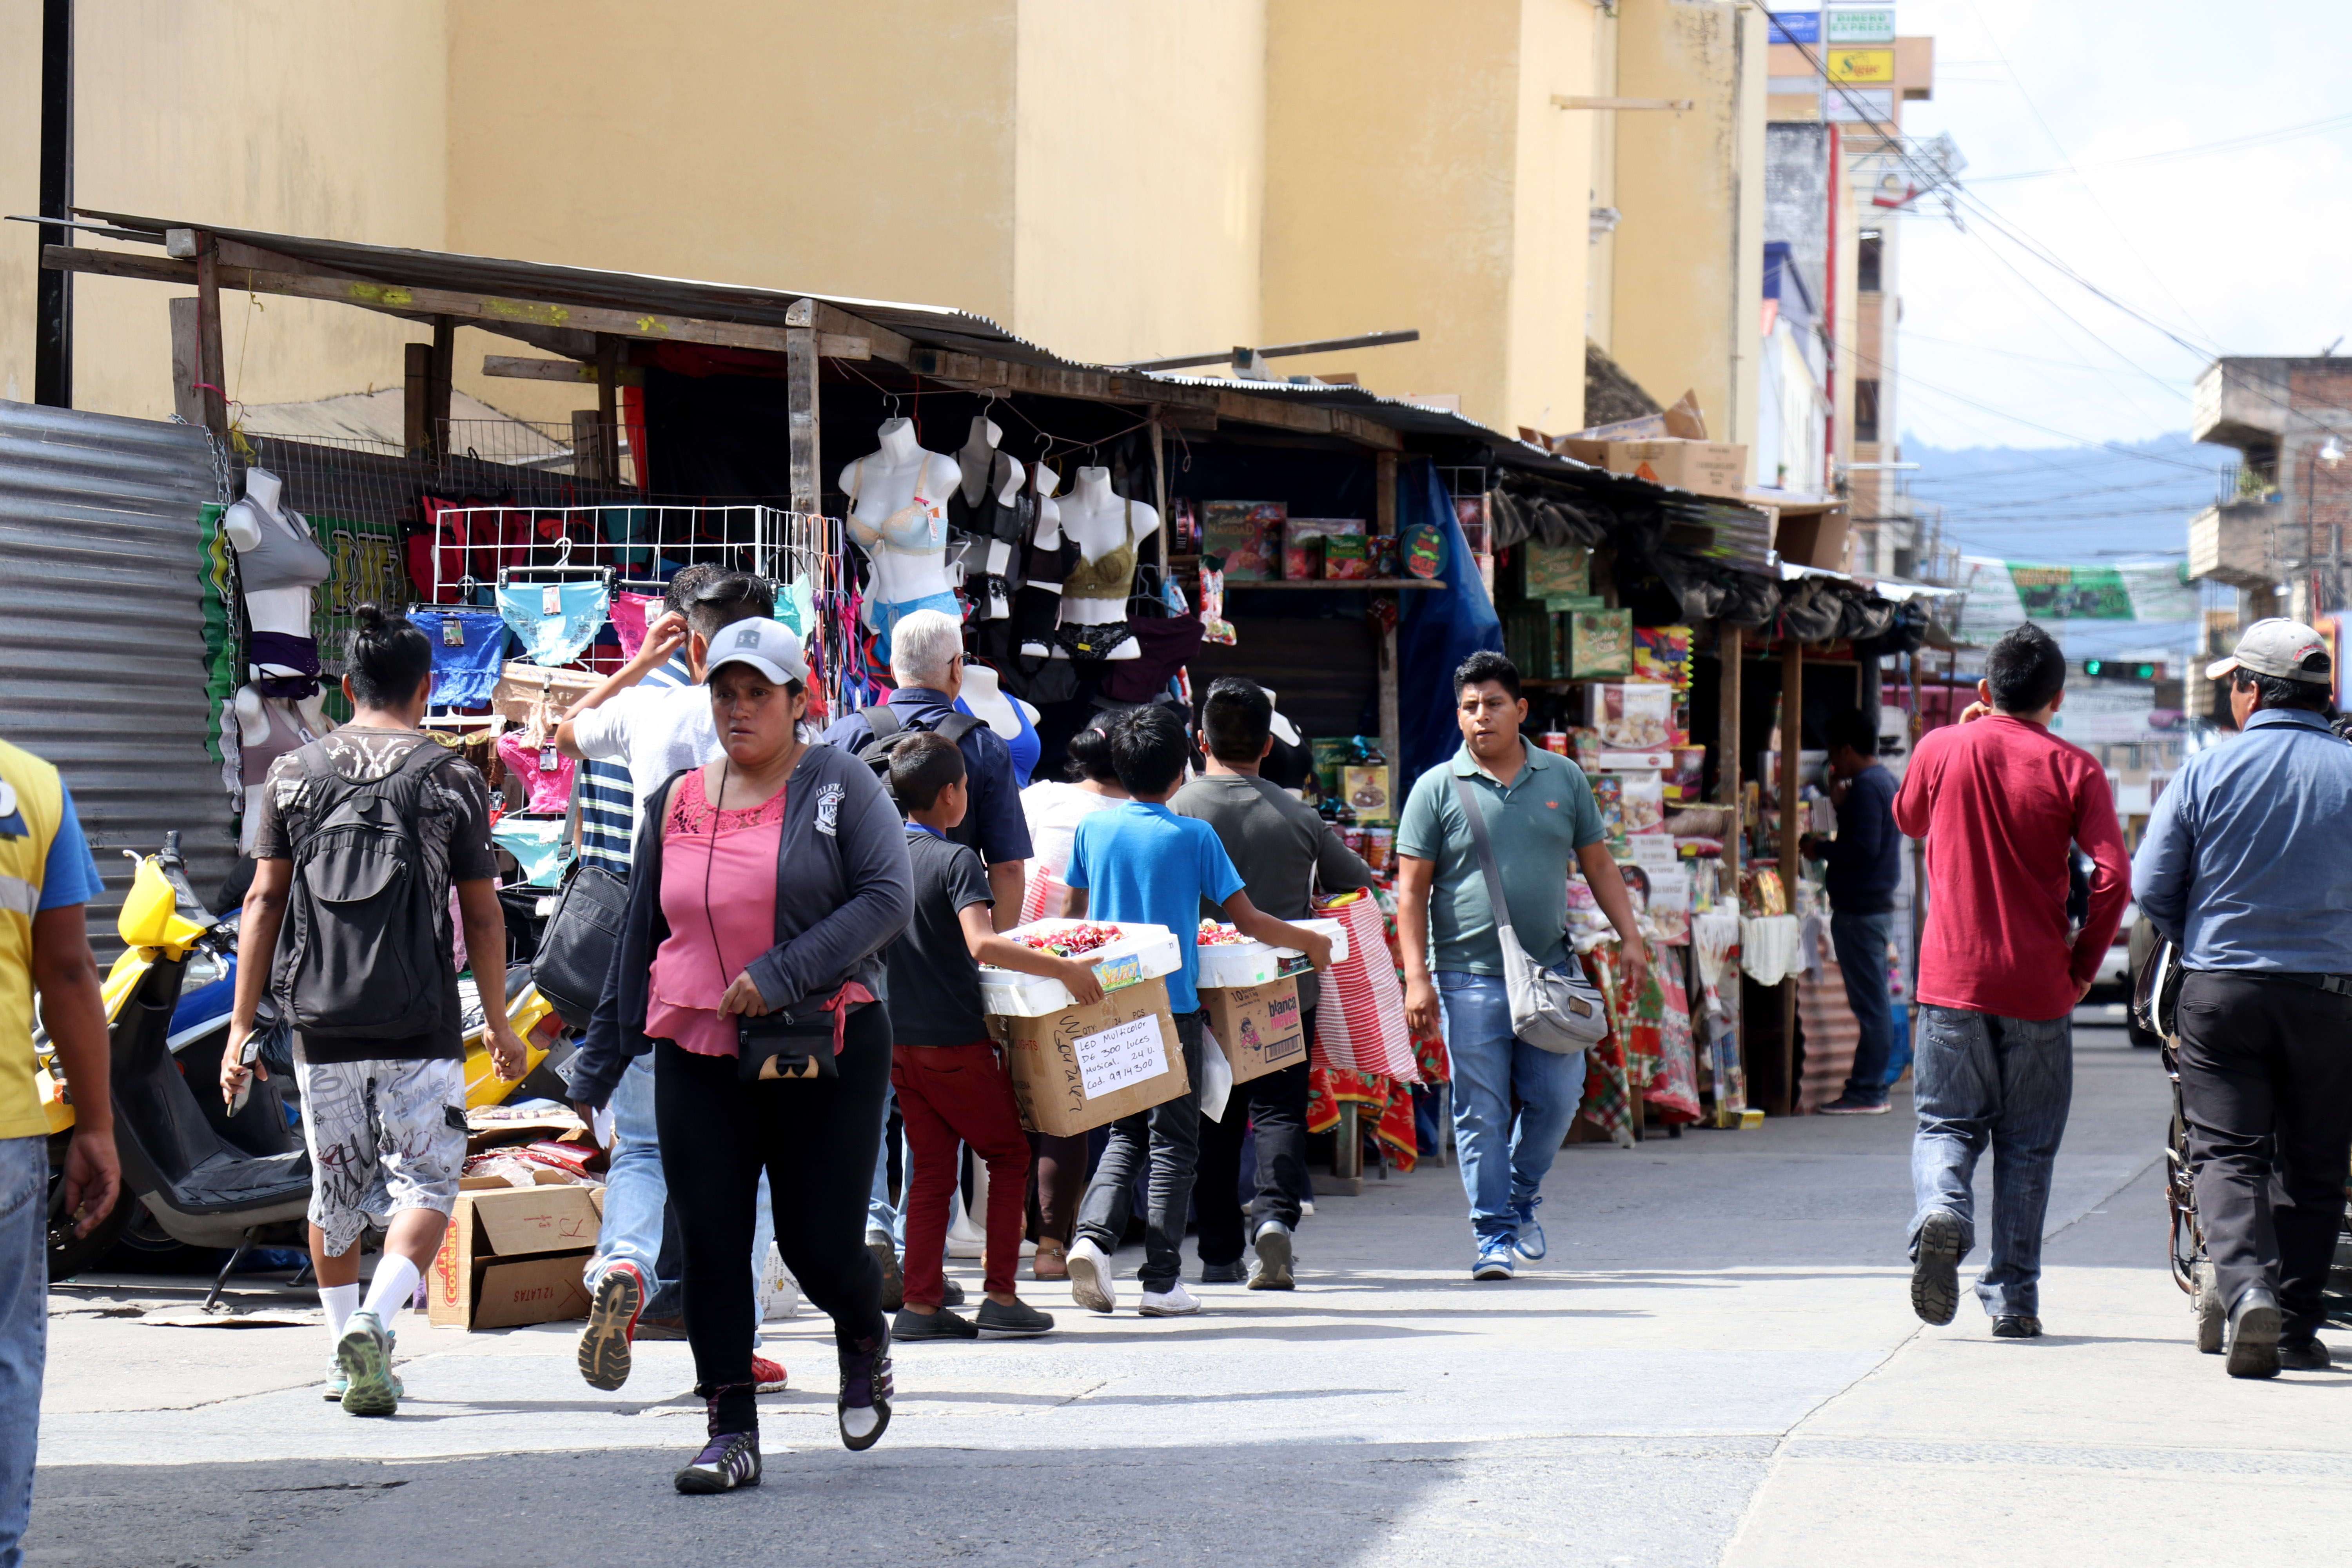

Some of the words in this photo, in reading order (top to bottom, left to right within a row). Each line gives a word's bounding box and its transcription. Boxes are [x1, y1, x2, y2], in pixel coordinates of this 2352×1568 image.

[1837, 13, 1886, 22] DINERO
[1831, 22, 1891, 31] EXPRESS
[1841, 56, 1880, 77] Sigue
[1208, 523, 1254, 535] NAVIDAD
[1332, 545, 1365, 555] NAVIDAD
[1541, 550, 1573, 564] Surtido
[1550, 562, 1570, 572] Rico
[1588, 629, 1619, 644] Surtido
[1597, 641, 1616, 653] Rico
[1231, 991, 1243, 1002] 10
[1268, 996, 1297, 1018] blanca
[1082, 1024, 1098, 1035] QTY:
[1114, 1017, 1122, 1025] 24
[1132, 1009, 1145, 1020] PCS
[1271, 1008, 1298, 1031] nieves
[1080, 1040, 1096, 1052] LED
[1103, 1021, 1146, 1044] Multicolor
[1016, 1039, 1038, 1051] LIGHTS
[1101, 1045, 1121, 1058] 300
[1086, 1058, 1120, 1075] Musical.
[1131, 1050, 1144, 1061] 24
[1087, 1077, 1105, 1090] Cod.
[438, 1252, 447, 1269] La
[513, 1287, 542, 1303] LATAS
[544, 1287, 554, 1300] 12
